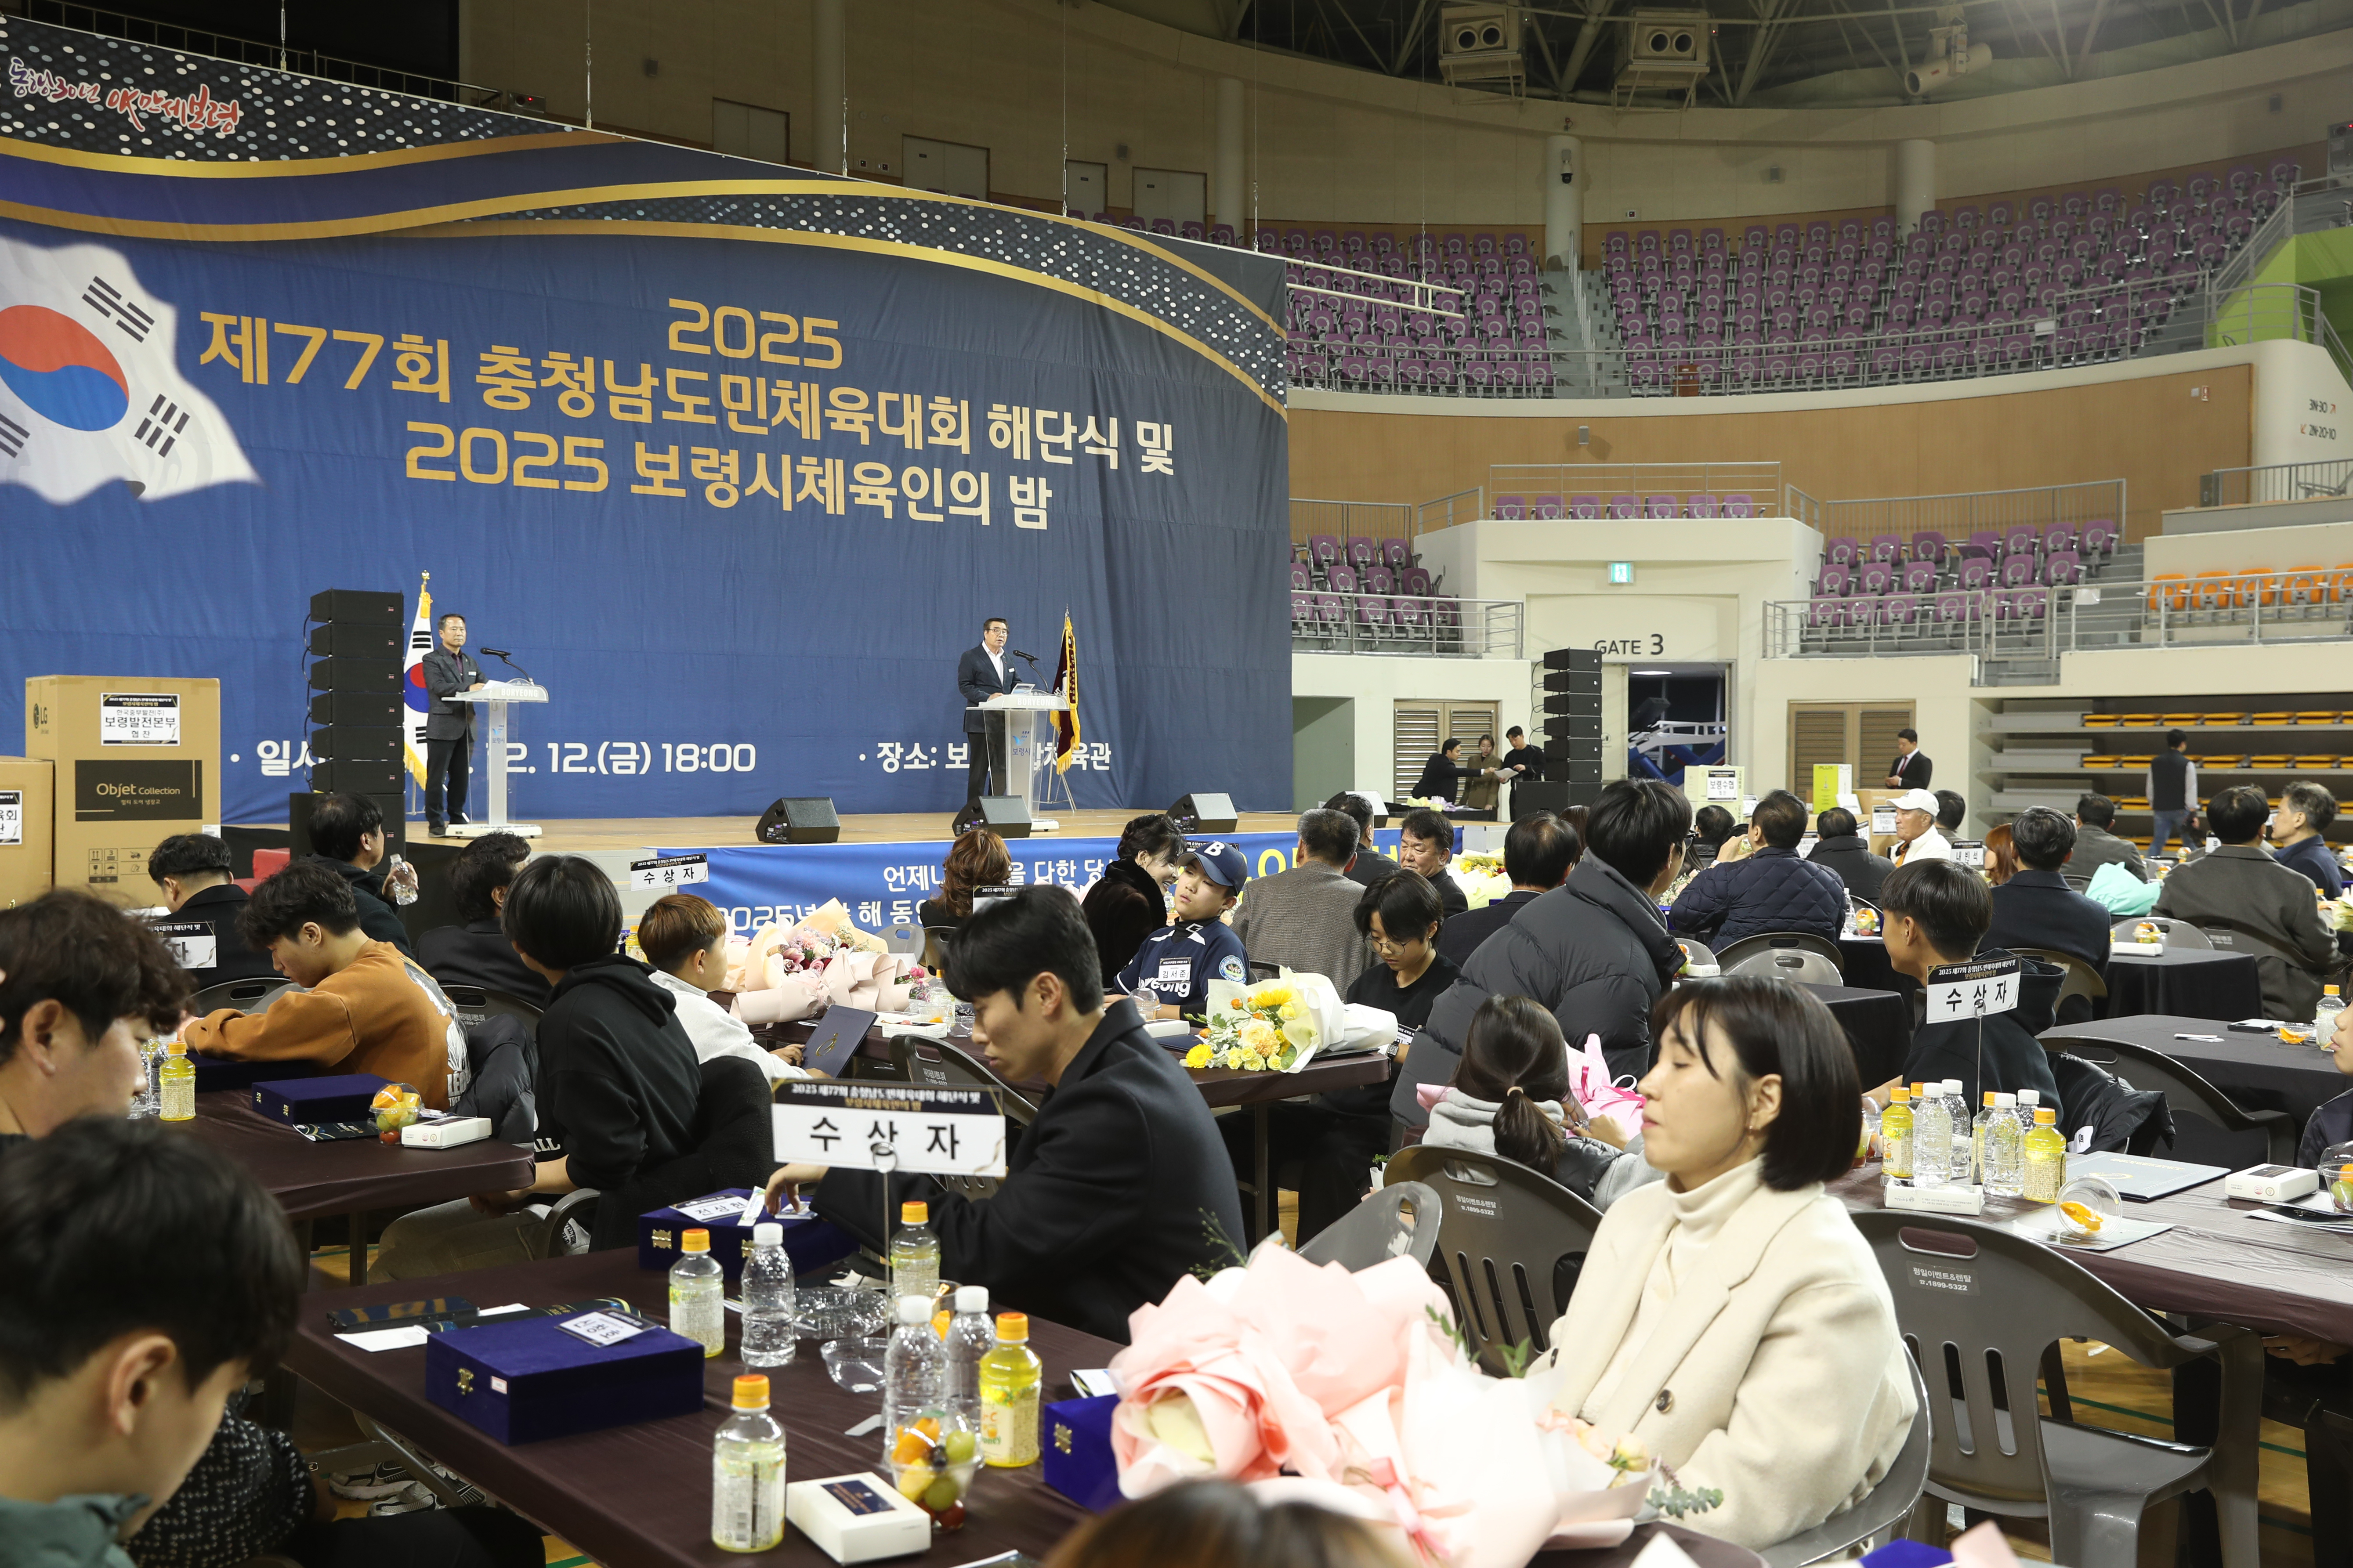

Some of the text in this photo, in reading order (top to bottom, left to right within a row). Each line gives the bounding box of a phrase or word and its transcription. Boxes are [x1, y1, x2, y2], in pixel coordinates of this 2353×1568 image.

[668, 298, 843, 370] 2025
[199, 311, 1174, 476] 제77회 충청남도민체육대회 해단식 및
[405, 421, 1053, 530] 2025 보령시체육인의 밤
[1594, 633, 1664, 655] GATE 3
[501, 688, 538, 697] BORYEONG
[1017, 697, 1056, 707] BORYEONG
[105, 716, 176, 728] 보령발전본부
[662, 743, 757, 773] 18:00
[877, 742, 937, 774] 장소:
[1012, 747, 1031, 756] 보령시
[96, 783, 181, 798] Objet Collection
[1710, 780, 1734, 790] 보령수협
[1204, 841, 1226, 856] B
[858, 901, 882, 927] 해
[1162, 970, 1186, 979] 김서준
[1952, 967, 1967, 975] 제77회
[1946, 980, 2007, 1012] 수상자
[810, 1116, 960, 1160] 수상자
[1913, 1267, 1972, 1283] 평일이벤트&렌탈
